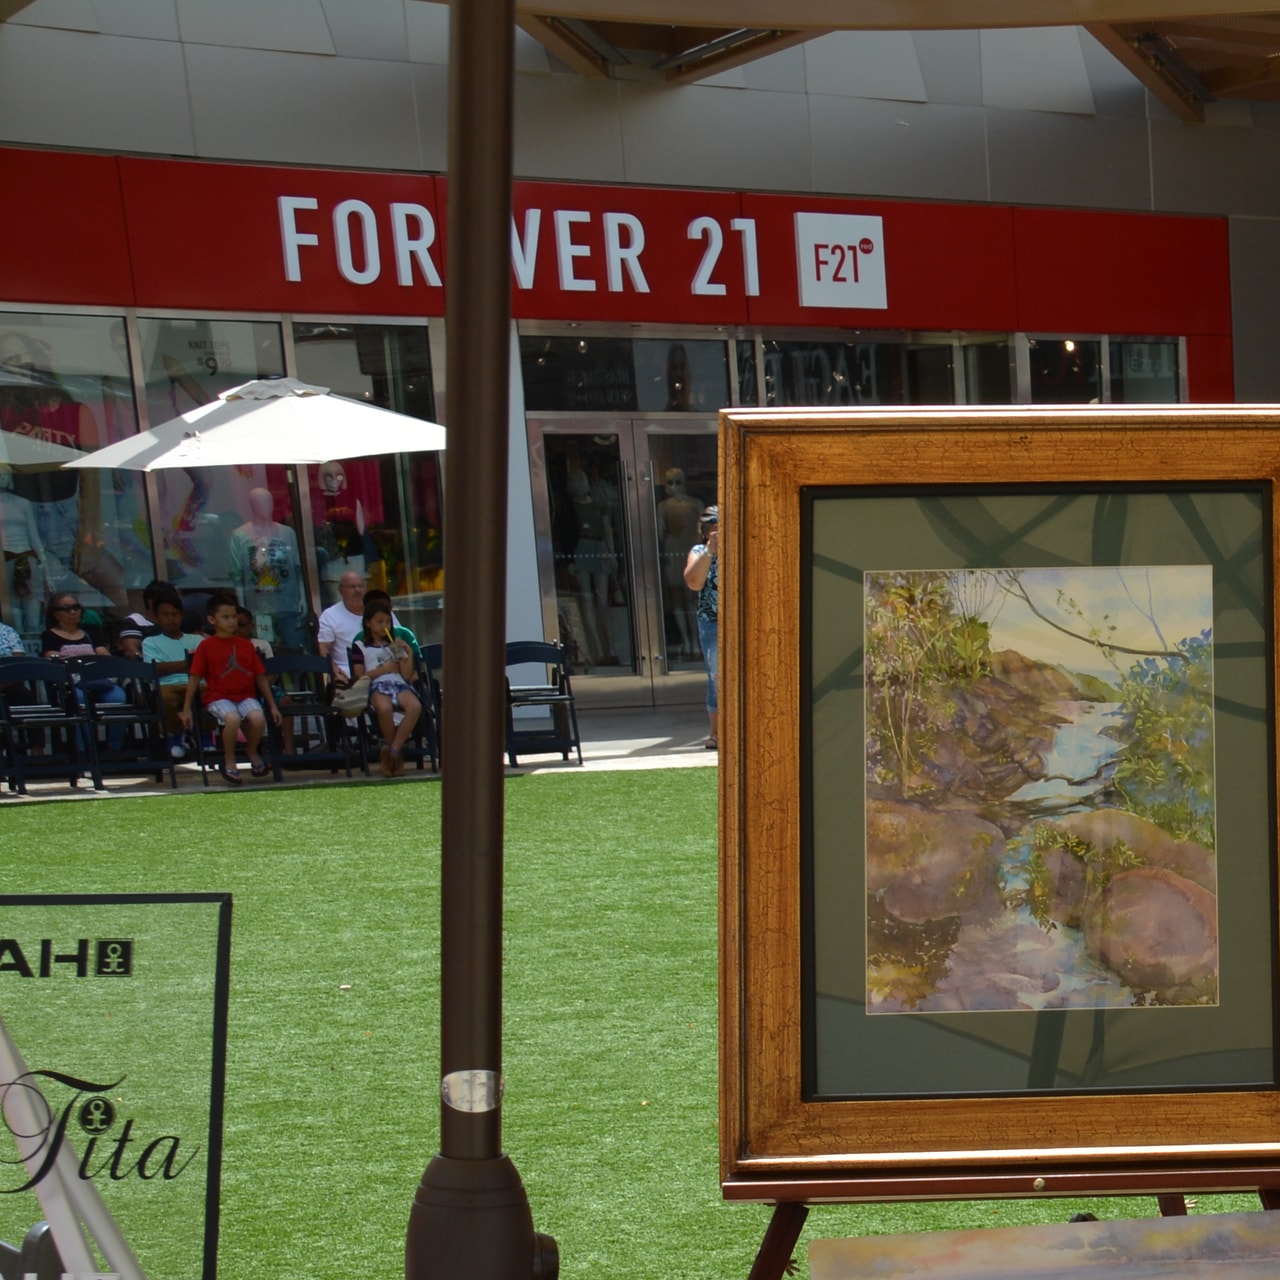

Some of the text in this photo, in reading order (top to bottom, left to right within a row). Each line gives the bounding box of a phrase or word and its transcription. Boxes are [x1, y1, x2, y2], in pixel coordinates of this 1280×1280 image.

[277, 195, 761, 297] FORVER 21
[813, 243, 859, 283] F21
